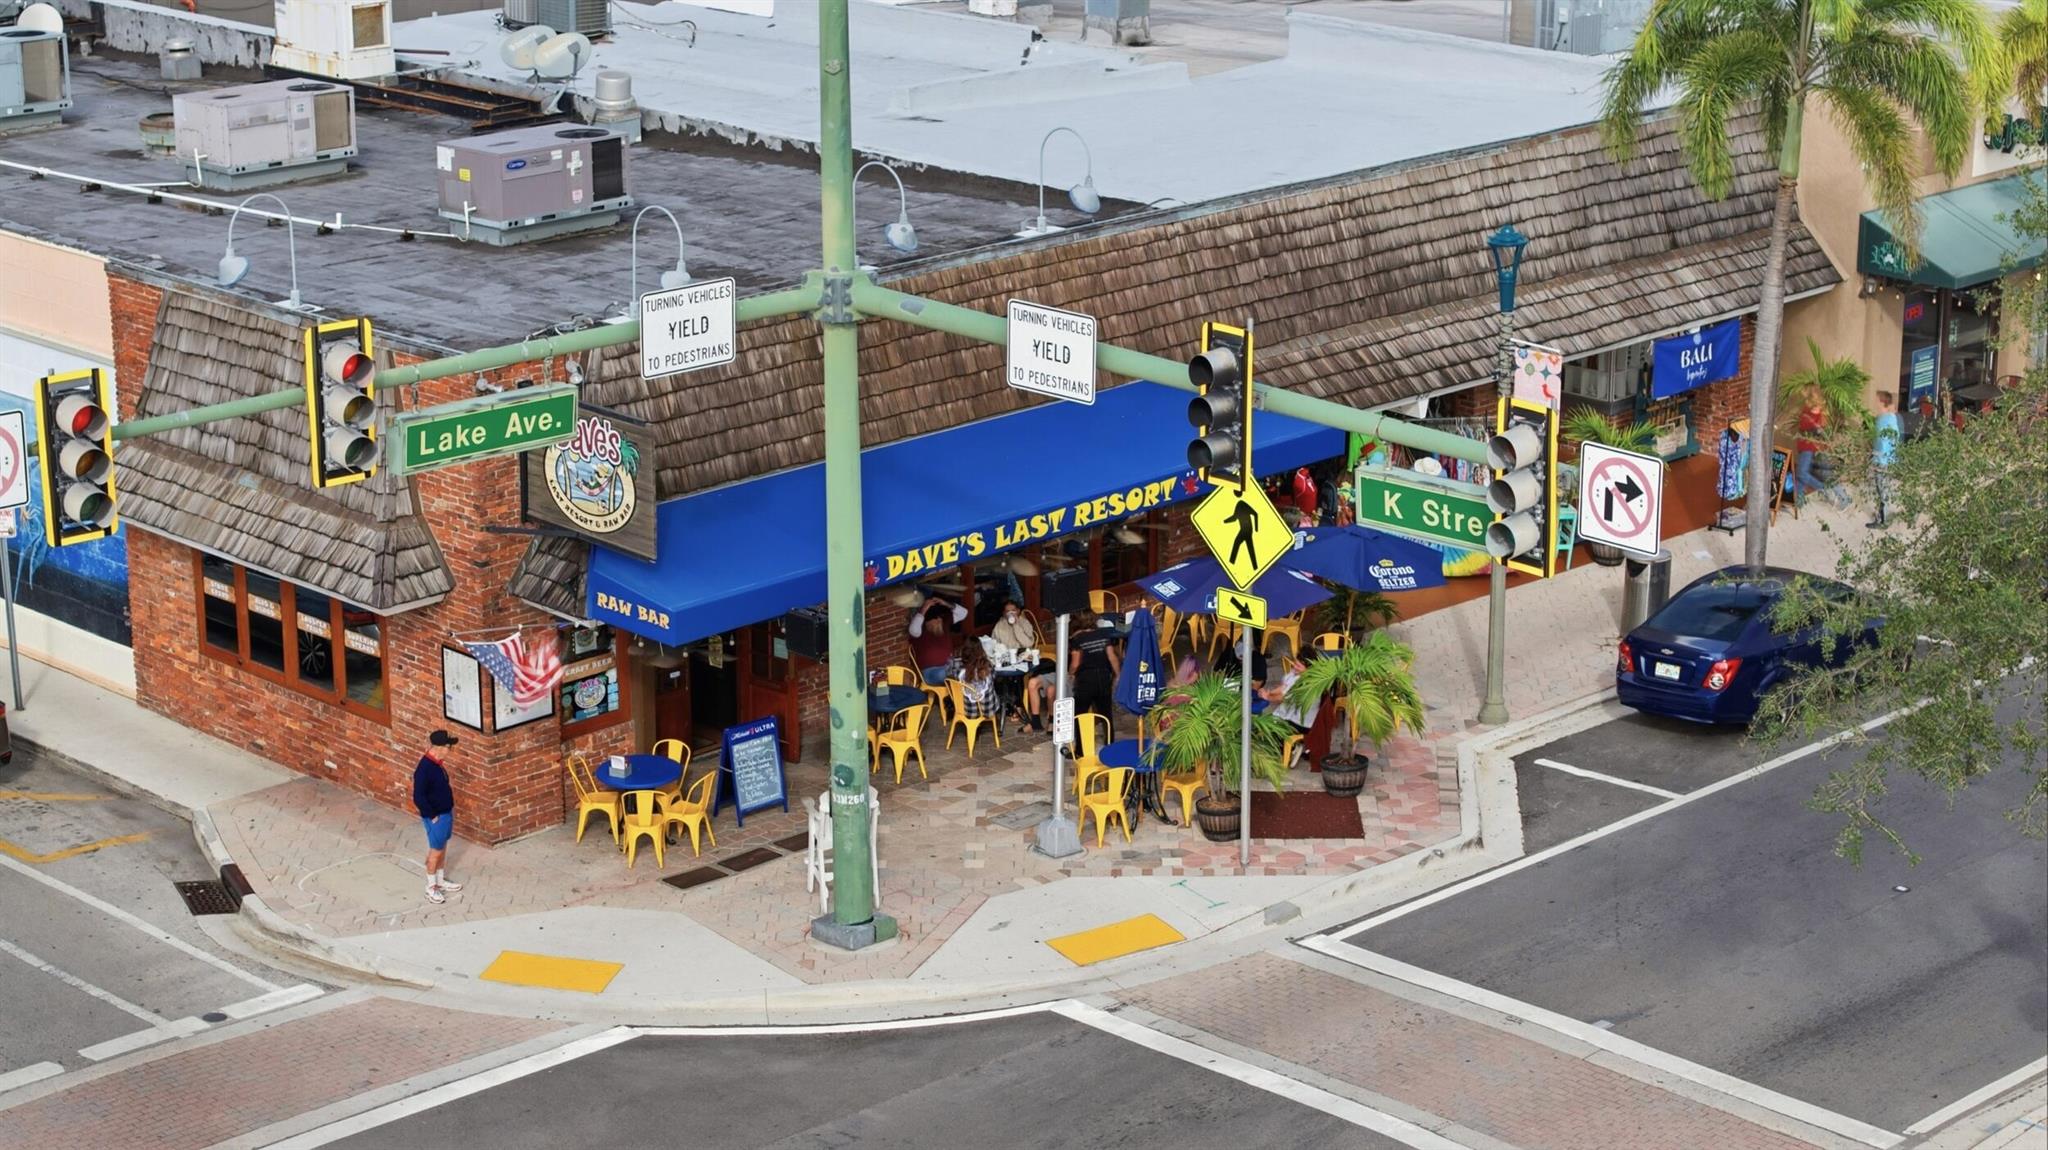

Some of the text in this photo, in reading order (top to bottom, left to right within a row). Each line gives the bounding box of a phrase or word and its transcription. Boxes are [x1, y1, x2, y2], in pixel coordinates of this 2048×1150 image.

[646, 285, 731, 312] TURNING VEHICLES
[668, 316, 709, 340] YIELD
[1013, 307, 1092, 337] TURNING VEHICLES
[648, 343, 730, 370] TO PEDESTRIANS
[1033, 339, 1071, 364] YIELD
[1681, 343, 1712, 368] BALI
[1013, 366, 1090, 396] TO PEDESTRIANS
[420, 412, 562, 456] Lake Ave.
[556, 417, 621, 465] ave's
[565, 504, 593, 526] RESORT
[603, 518, 619, 529] RAW
[620, 503, 632, 522] BAR
[1383, 490, 1484, 537] K Stre
[885, 476, 1178, 581] DAVE'S LAST RESORT
[1368, 564, 1415, 579] Corona
[1378, 576, 1416, 587] SELTZER
[596, 591, 670, 630] RAW BAR
[754, 722, 775, 734] ULTRA
